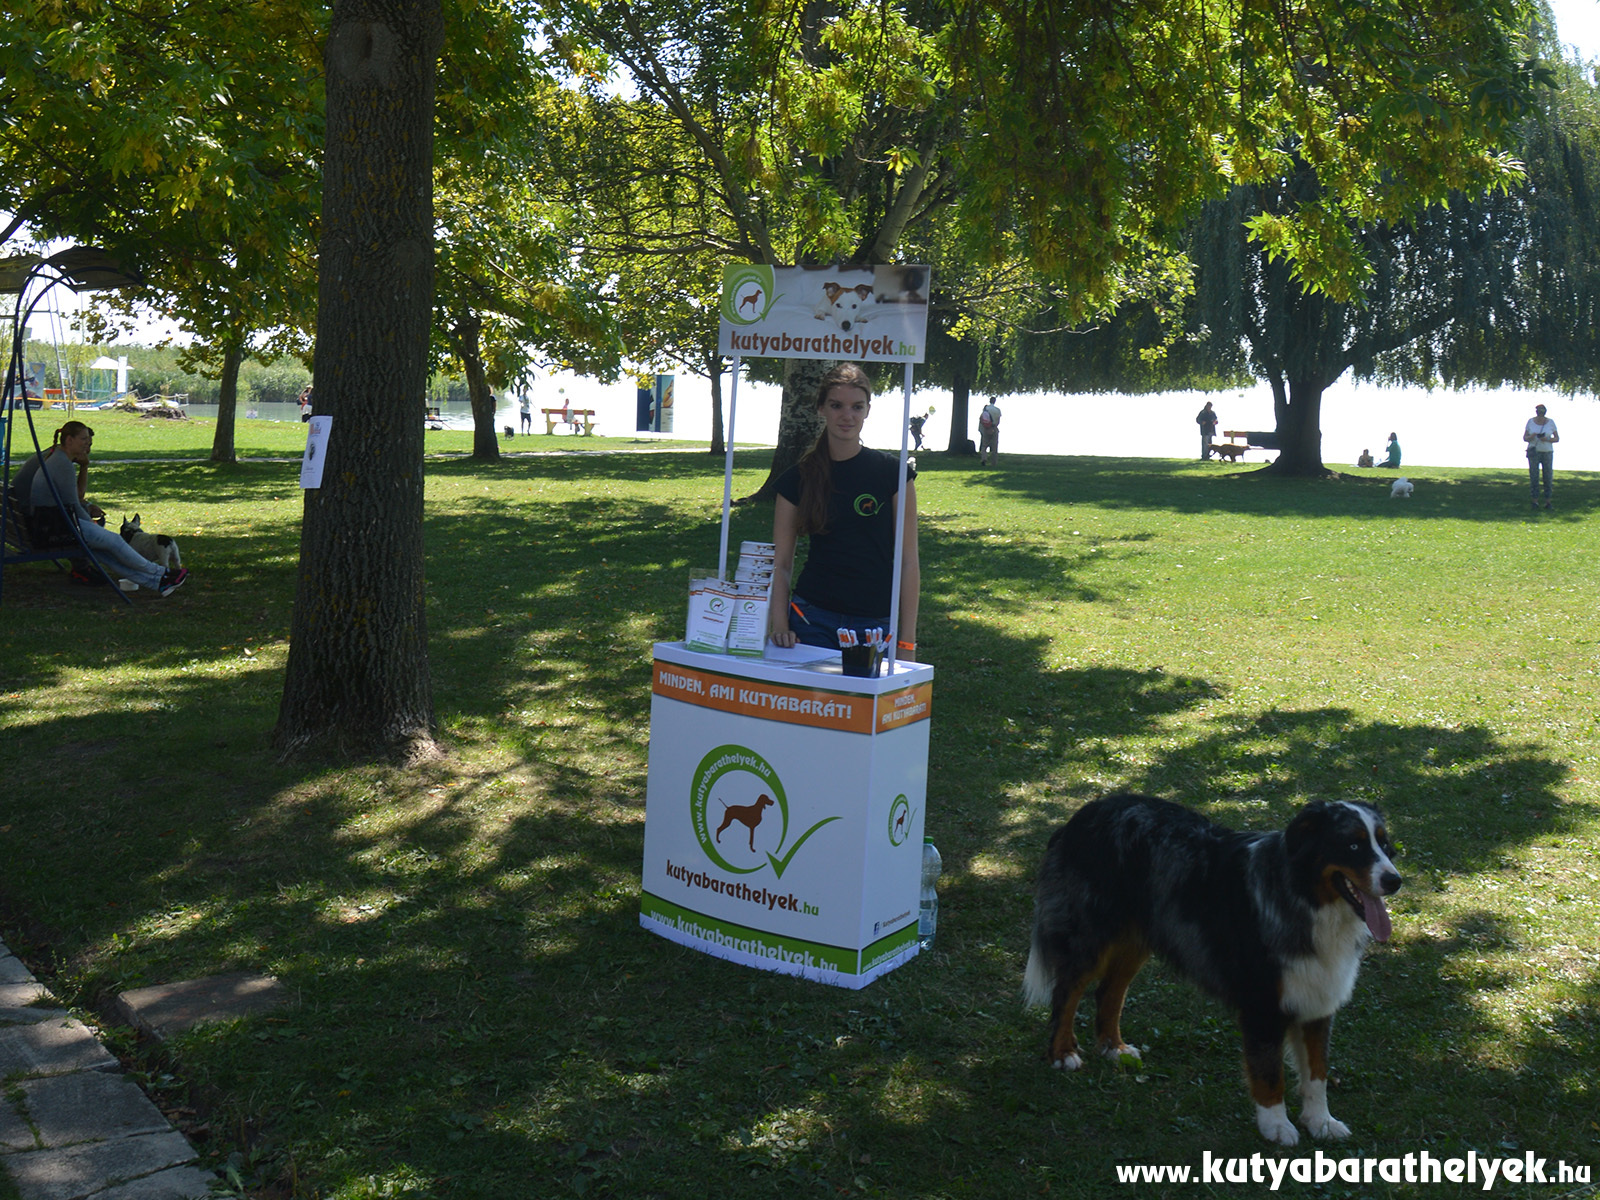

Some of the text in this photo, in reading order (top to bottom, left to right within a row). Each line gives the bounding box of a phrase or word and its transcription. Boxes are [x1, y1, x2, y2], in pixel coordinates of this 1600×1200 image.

[731, 331, 916, 358] kutyabarathelyek.hu
[659, 671, 852, 719] MINDEN, AMI KUTYABARÁT!
[695, 753, 771, 843] www.kutyabarathelyek.hu
[666, 860, 819, 916] kutyabarathelyek.hu
